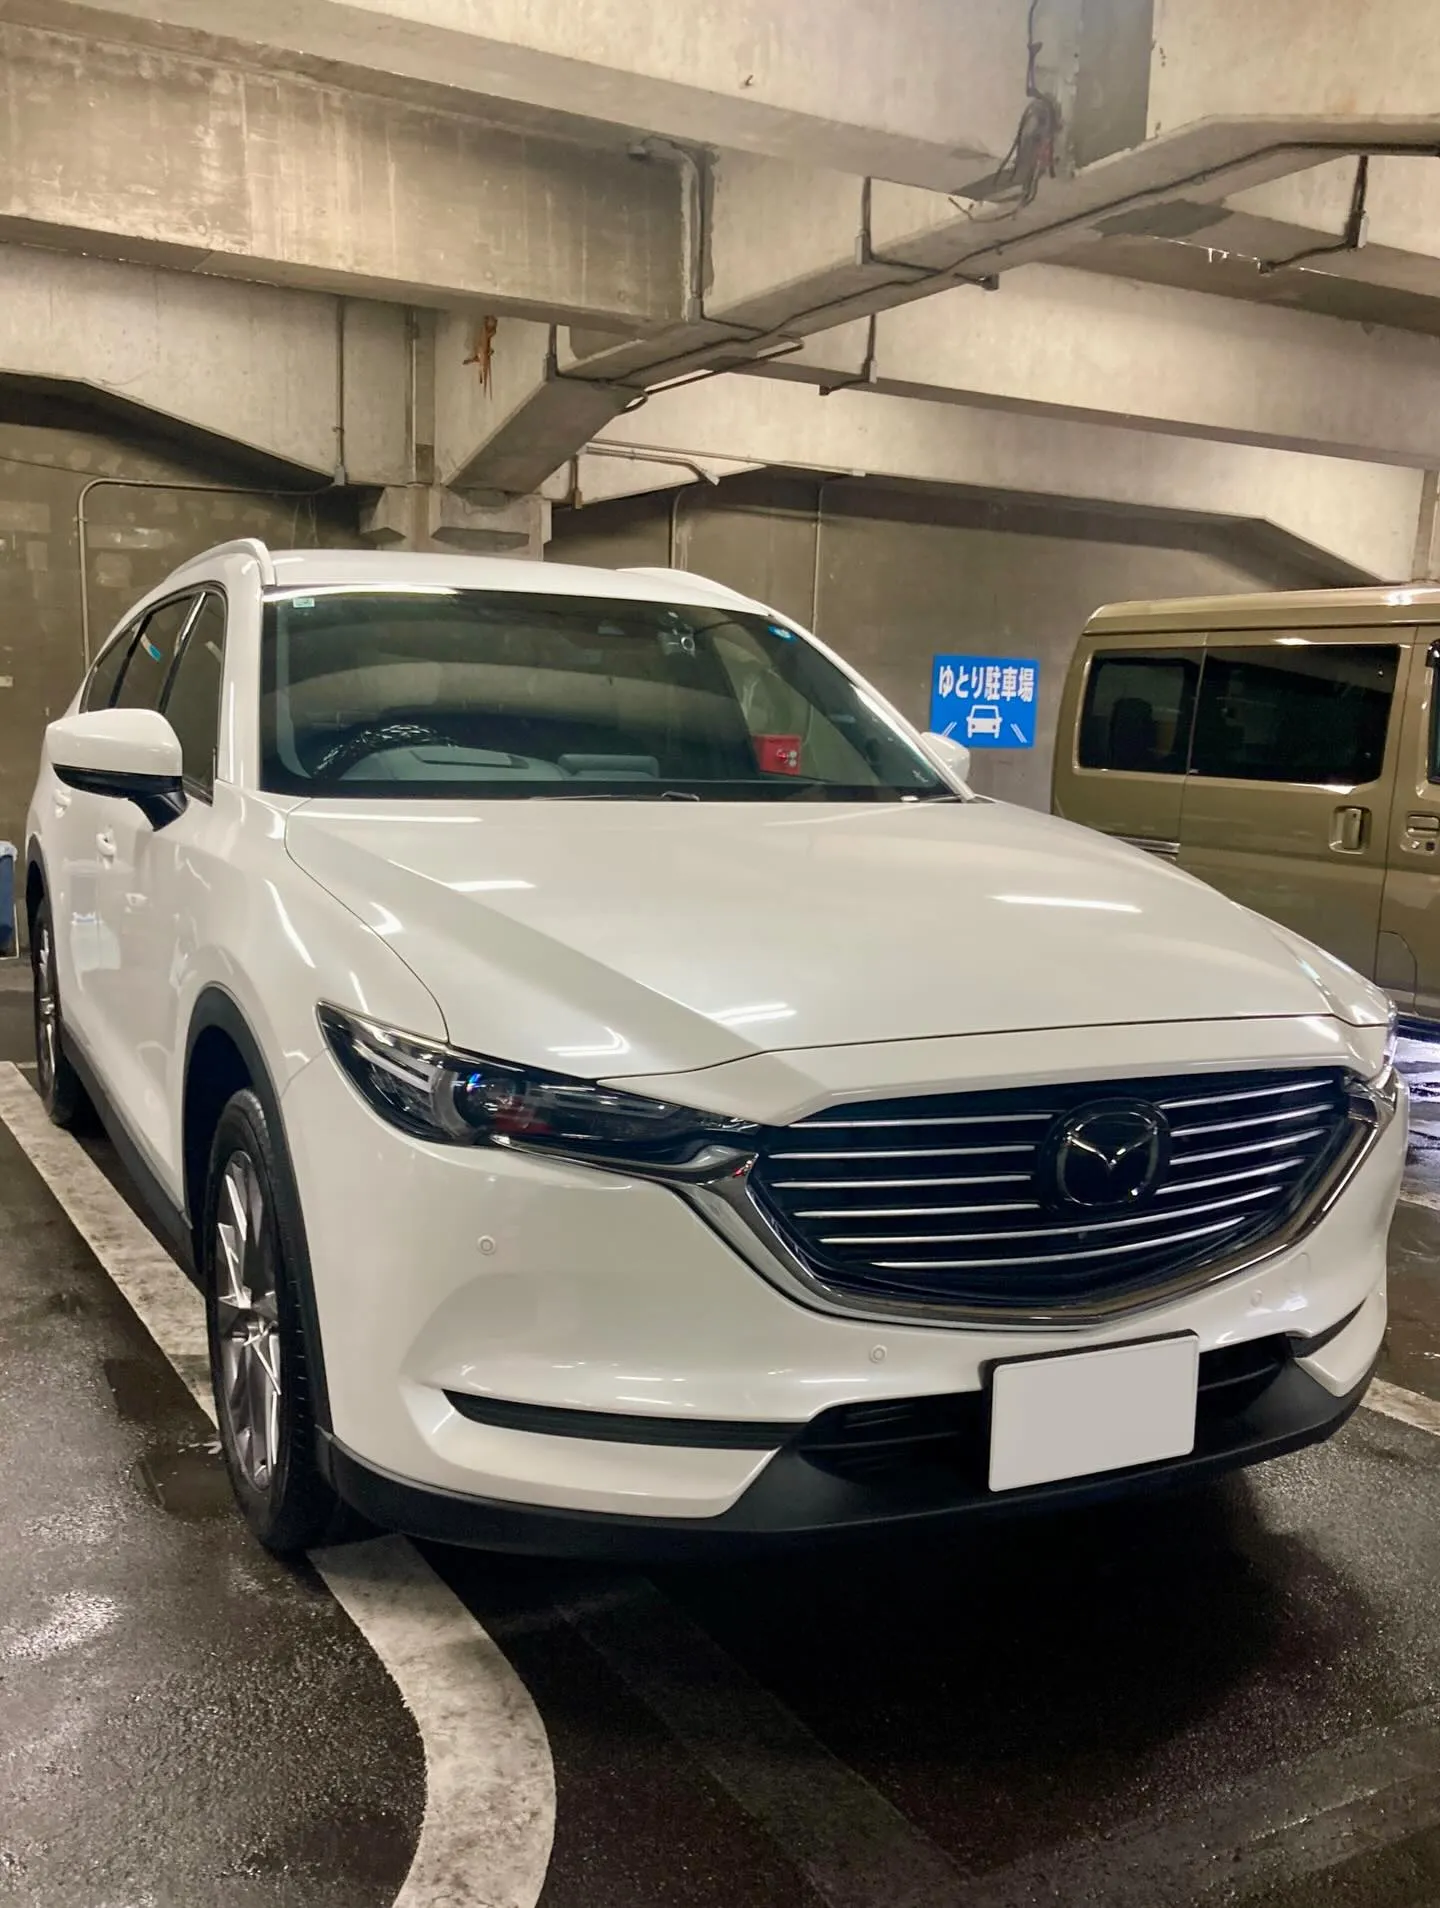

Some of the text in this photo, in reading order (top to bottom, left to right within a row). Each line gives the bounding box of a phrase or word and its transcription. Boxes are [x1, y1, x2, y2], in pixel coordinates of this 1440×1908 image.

[938, 665, 1034, 702] ゆとり駐車場
